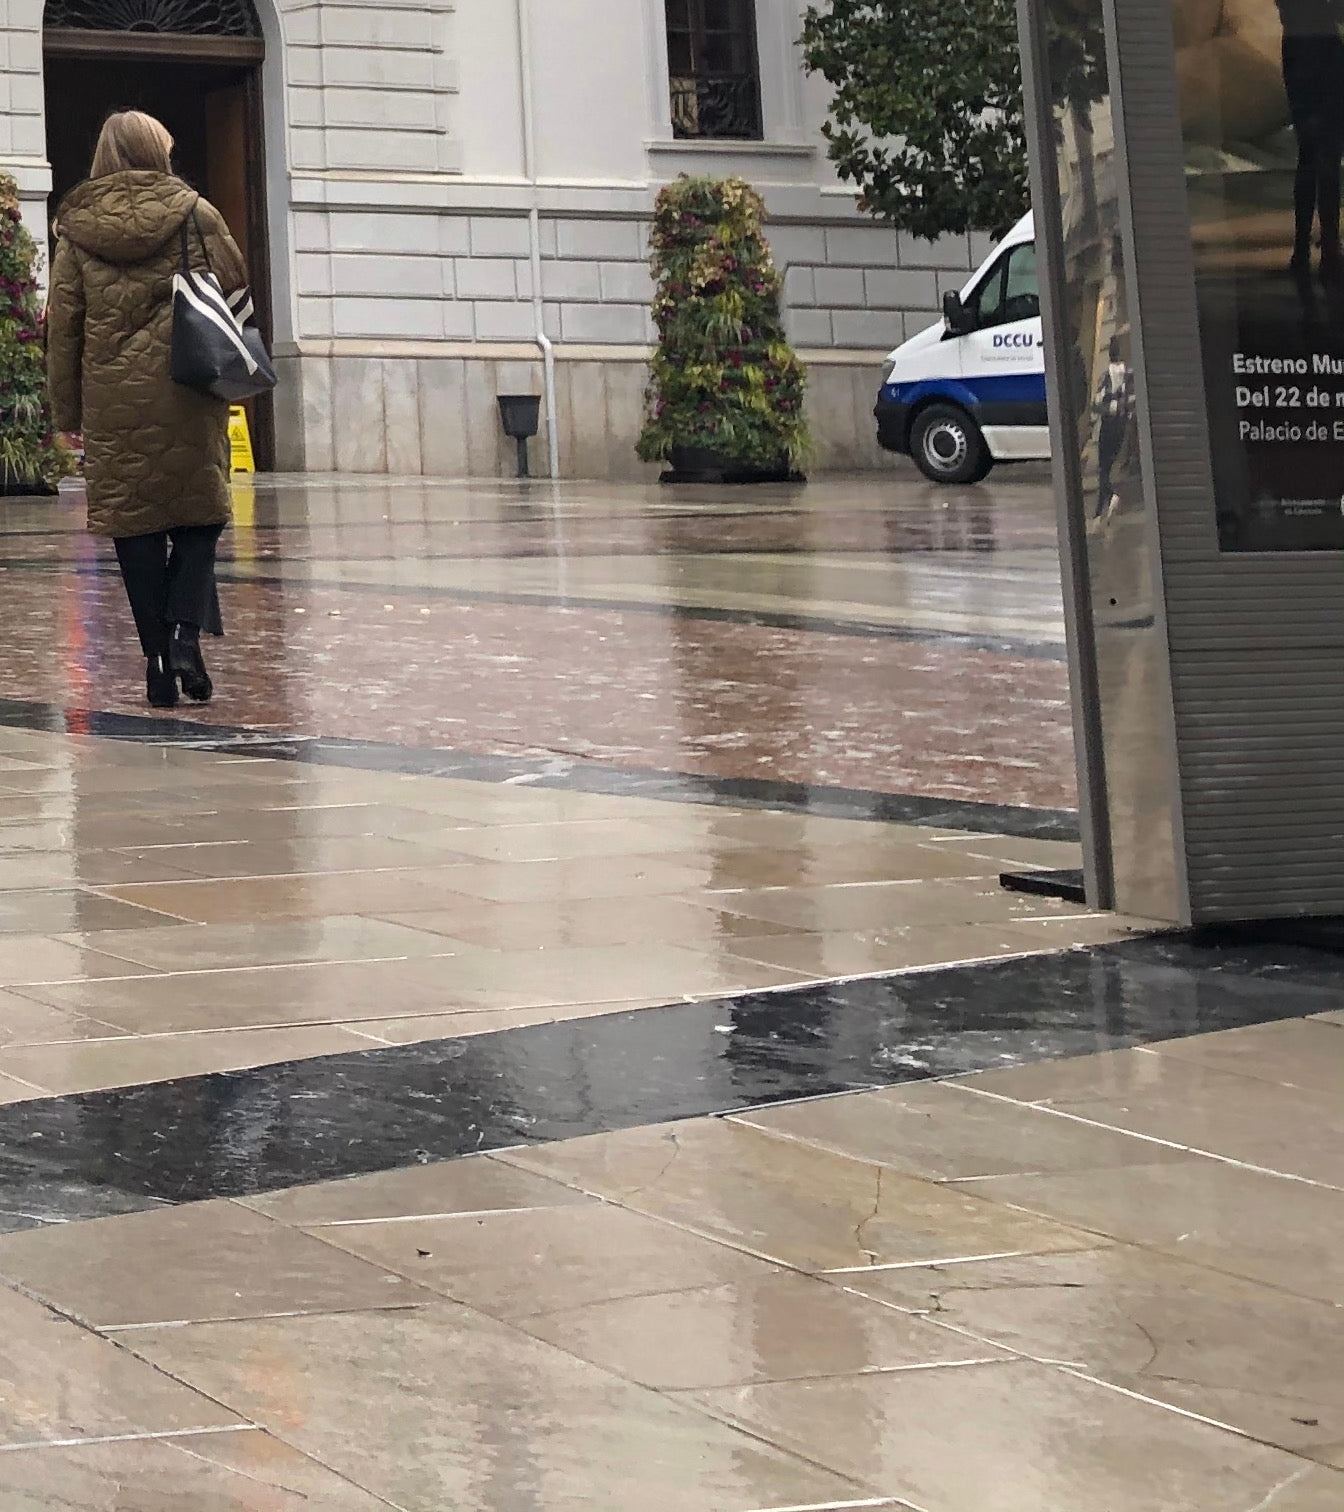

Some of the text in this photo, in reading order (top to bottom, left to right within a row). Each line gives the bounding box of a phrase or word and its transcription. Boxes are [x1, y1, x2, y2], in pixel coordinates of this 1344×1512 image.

[993, 333, 1033, 348] DCCU
[1232, 353, 1344, 374] Estreno Mu
[1235, 385, 1270, 408] Del
[1275, 386, 1302, 408] 22
[1306, 385, 1330, 407] de
[1239, 420, 1301, 441] Palacio
[1305, 420, 1328, 441] de
